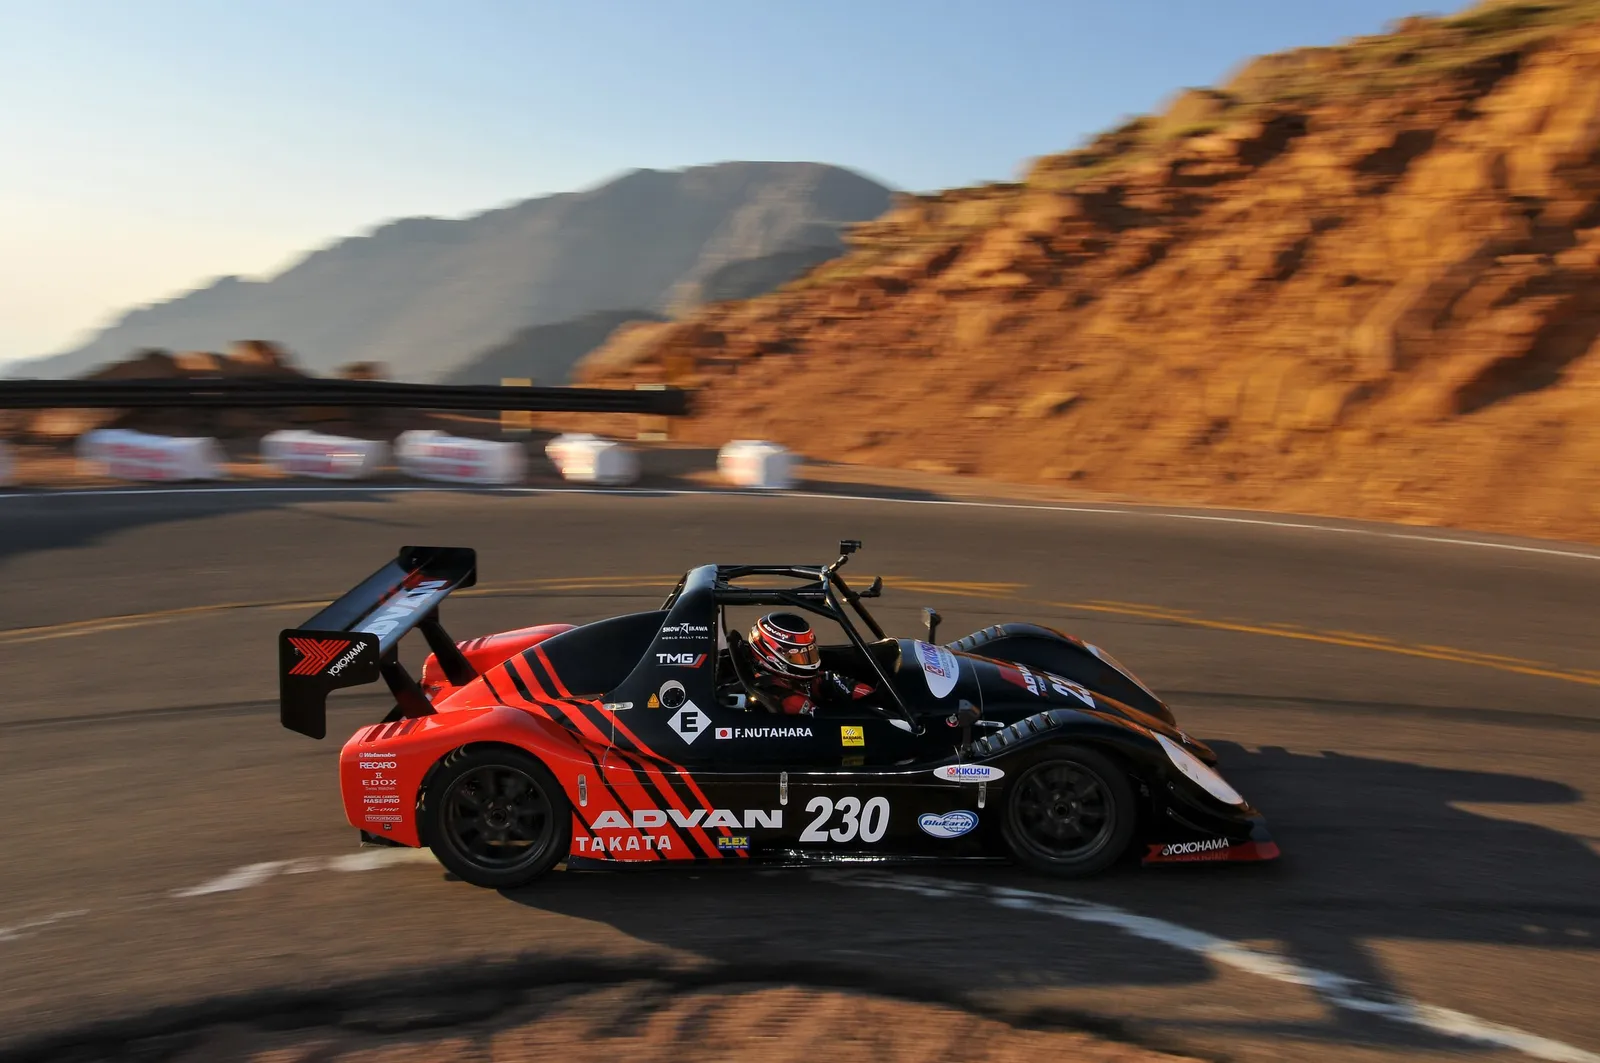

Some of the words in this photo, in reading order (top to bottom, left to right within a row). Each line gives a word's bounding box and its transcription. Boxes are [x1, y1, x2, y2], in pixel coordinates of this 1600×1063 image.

[360, 580, 448, 641] DVAN
[327, 641, 368, 677] YOKOHAMA
[656, 653, 694, 664] TMG
[680, 712, 699, 733] E
[735, 727, 813, 738] F.NUTAHARA
[360, 761, 397, 770] RECARO
[956, 767, 990, 776] KIKUSUI
[590, 809, 783, 829] ADVAN
[799, 796, 890, 843] 230
[923, 819, 972, 827] BluEarth
[575, 835, 672, 852] TAKATA
[718, 837, 748, 846] FLEX
[1167, 837, 1230, 855] YOKOHAMA
